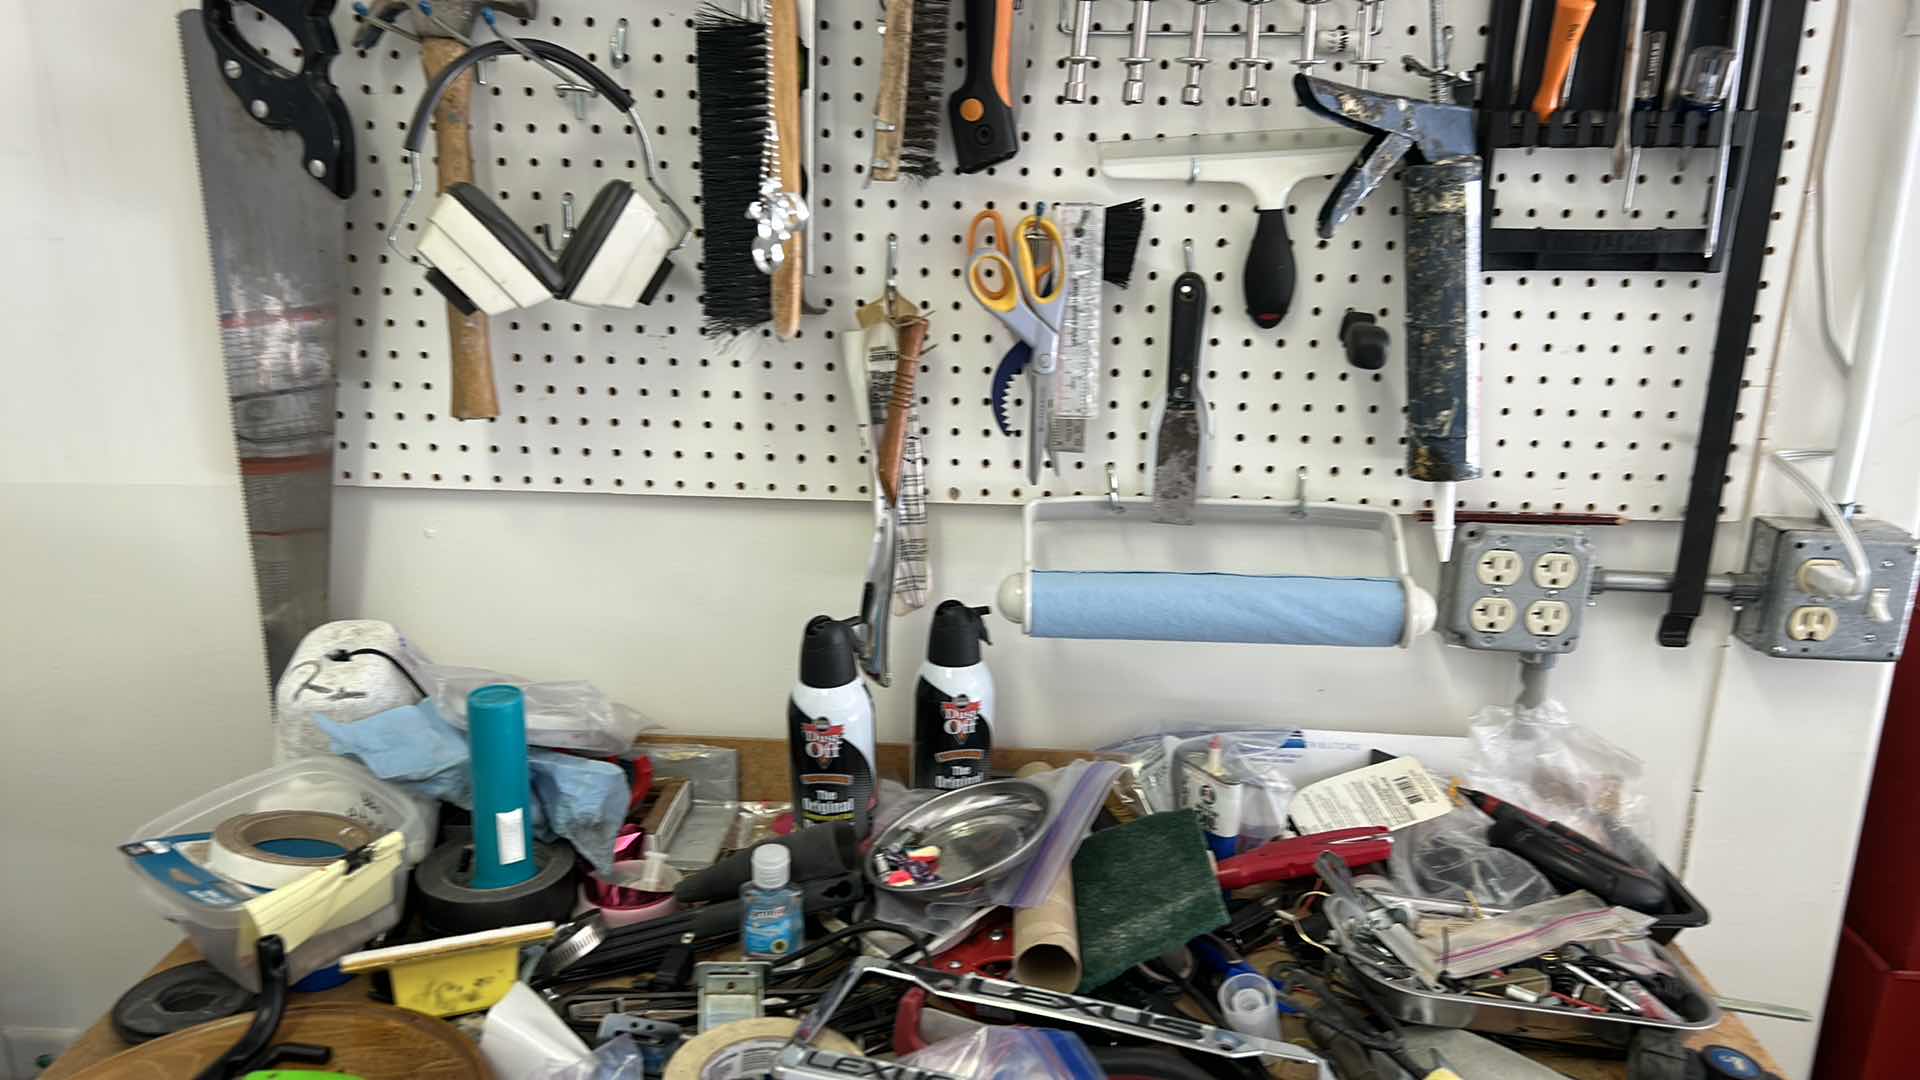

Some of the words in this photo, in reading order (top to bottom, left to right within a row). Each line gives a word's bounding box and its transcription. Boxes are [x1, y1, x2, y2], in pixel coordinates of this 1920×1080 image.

[943, 719, 977, 735] Off
[805, 741, 841, 758] Off
[951, 765, 972, 775] The
[815, 790, 838, 800] The
[801, 798, 854, 815] Original
[969, 976, 1204, 1041] LEXUS
